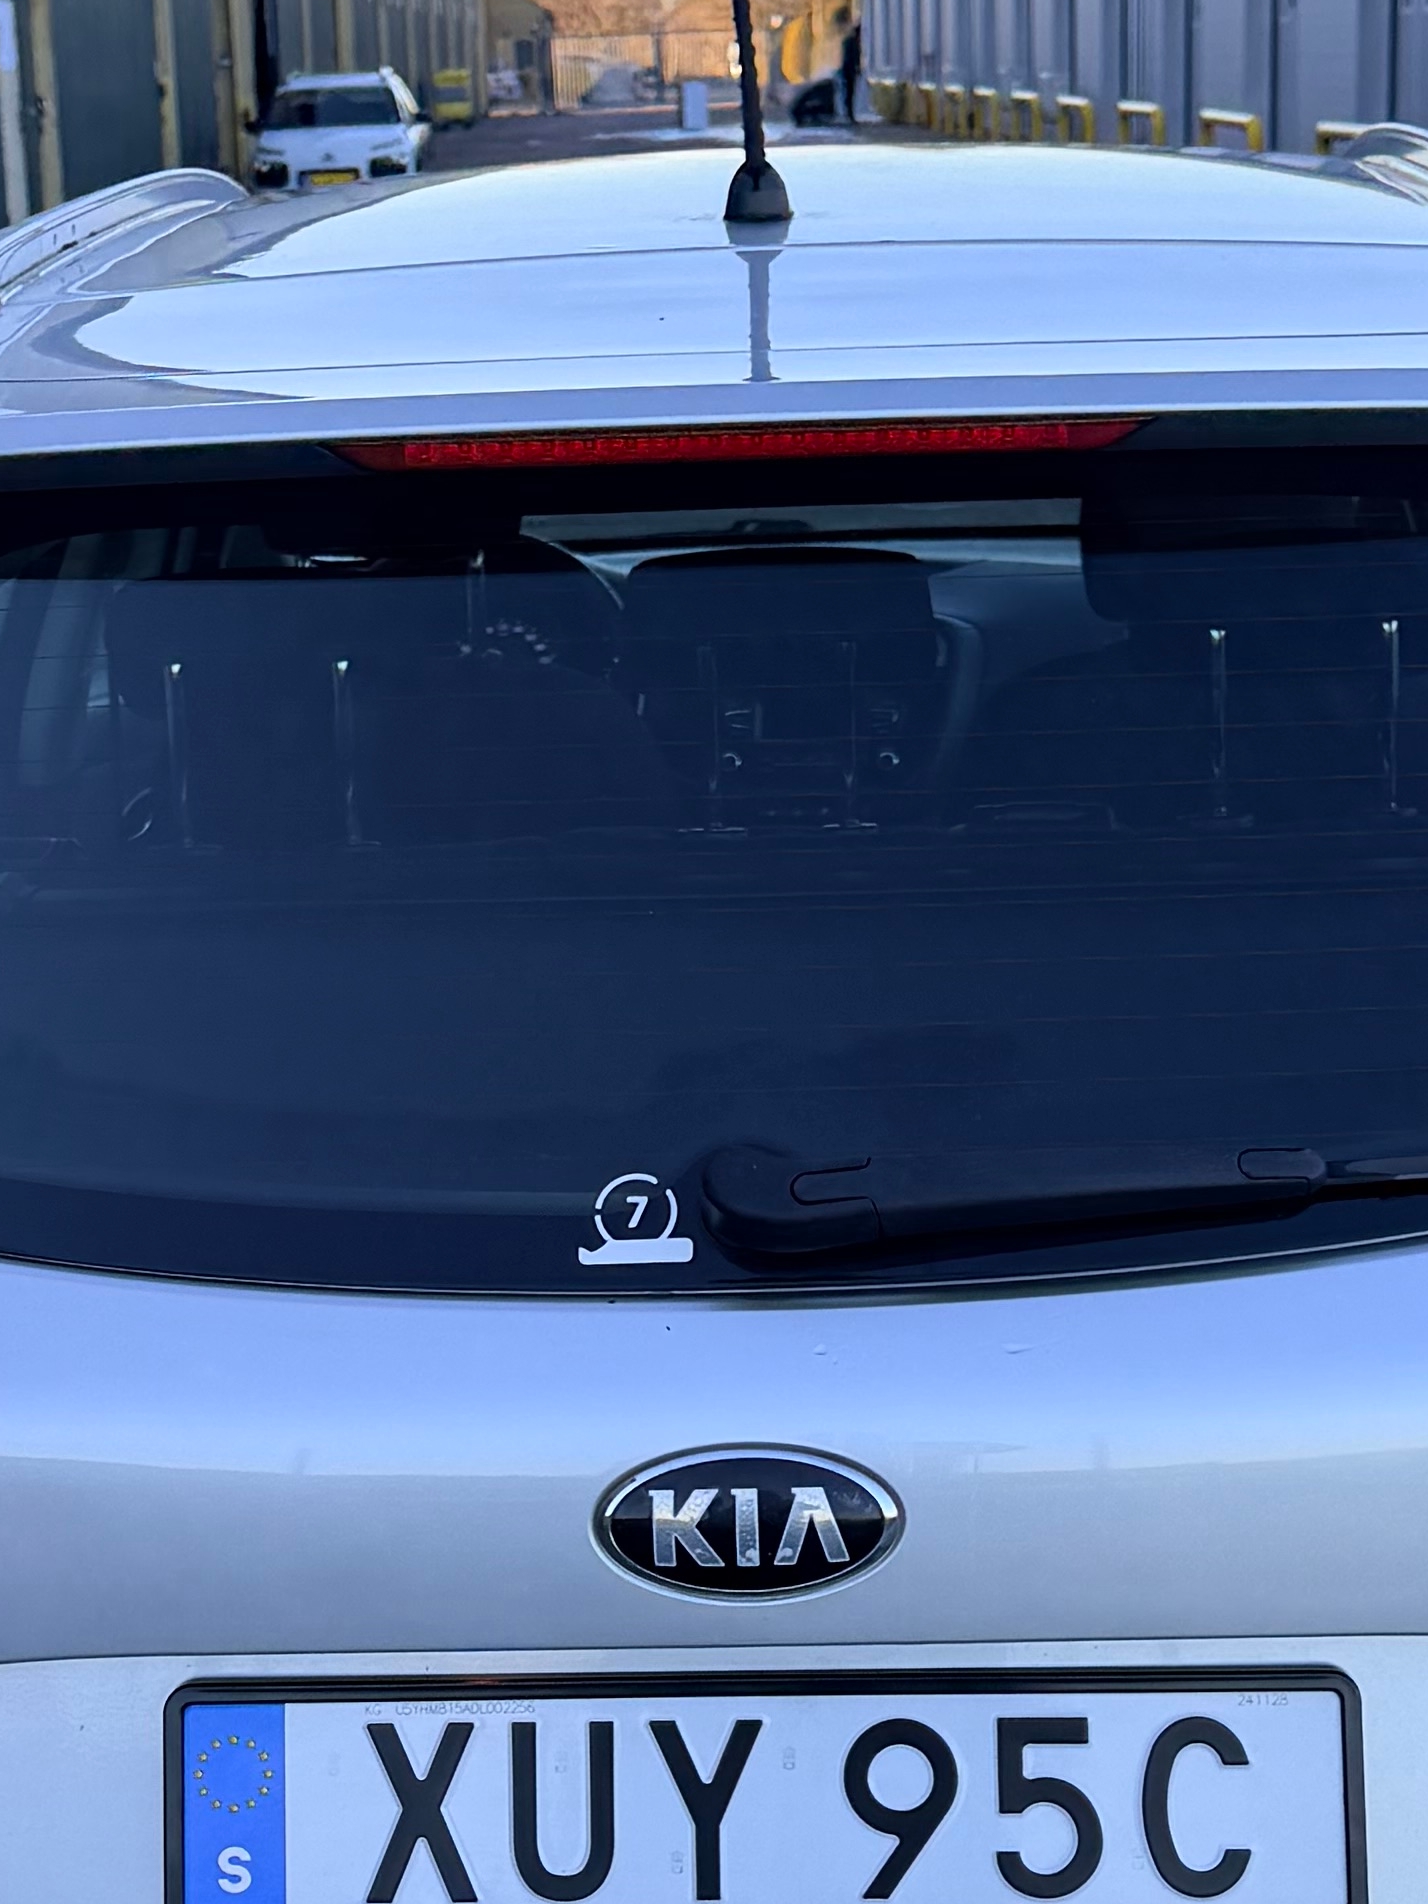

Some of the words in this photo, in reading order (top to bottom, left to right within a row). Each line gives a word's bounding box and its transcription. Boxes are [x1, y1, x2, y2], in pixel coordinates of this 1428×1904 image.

[626, 1196, 649, 1229] 7
[648, 1487, 850, 1567] KIA
[365, 1719, 763, 1903] XUY
[843, 1715, 1252, 1900] 95C
[217, 1846, 252, 1894] S
